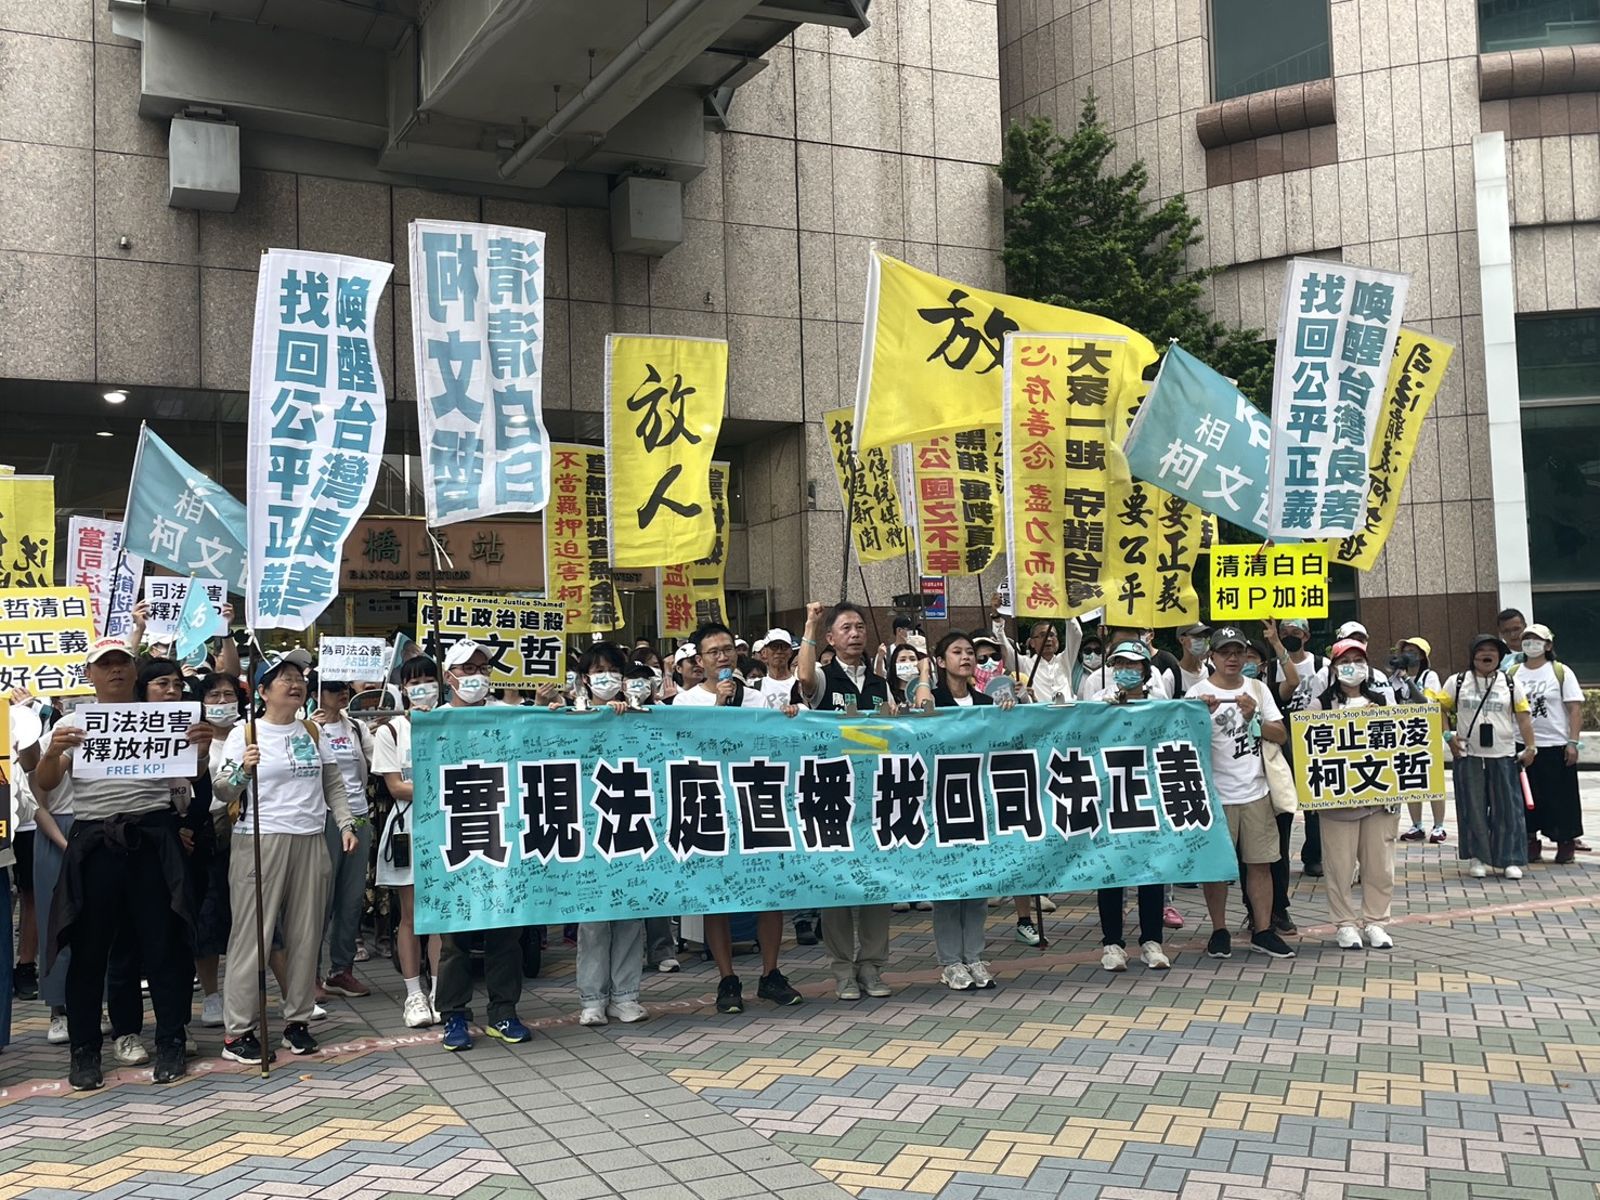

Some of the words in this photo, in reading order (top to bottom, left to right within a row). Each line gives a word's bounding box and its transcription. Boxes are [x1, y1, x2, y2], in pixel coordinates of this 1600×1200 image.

[1281, 272, 1346, 530] 找回公平正義
[1320, 280, 1395, 530] 喚醒台灣良善
[258, 269, 330, 616] 找回公平正義
[279, 276, 377, 616] 喚醒台灣良善
[626, 364, 702, 529] 放人
[1216, 554, 1323, 578] 清清白白
[152, 583, 222, 602] 司法害
[503, 598, 531, 607] Justice
[1216, 585, 1324, 609] 柯P加油
[421, 604, 564, 631] 停止政治追殺
[322, 644, 382, 656] 為司法公義
[85, 710, 192, 733] 司法迫害
[1293, 714, 1311, 722] Stop
[1312, 712, 1341, 721] bullying
[1342, 710, 1360, 719] Stop
[1361, 708, 1390, 718] bullying
[1391, 706, 1409, 716] Stop
[1410, 704, 1439, 714] bullying
[1304, 717, 1429, 755] 停止霸凌
[82, 737, 190, 762] 釋放柯P
[106, 765, 139, 776] FREE
[143, 763, 166, 774] KP!
[1308, 751, 1431, 797] 柯文哲
[442, 757, 852, 868] 實現法庭直播
[874, 742, 1211, 846] 找回司法正義
